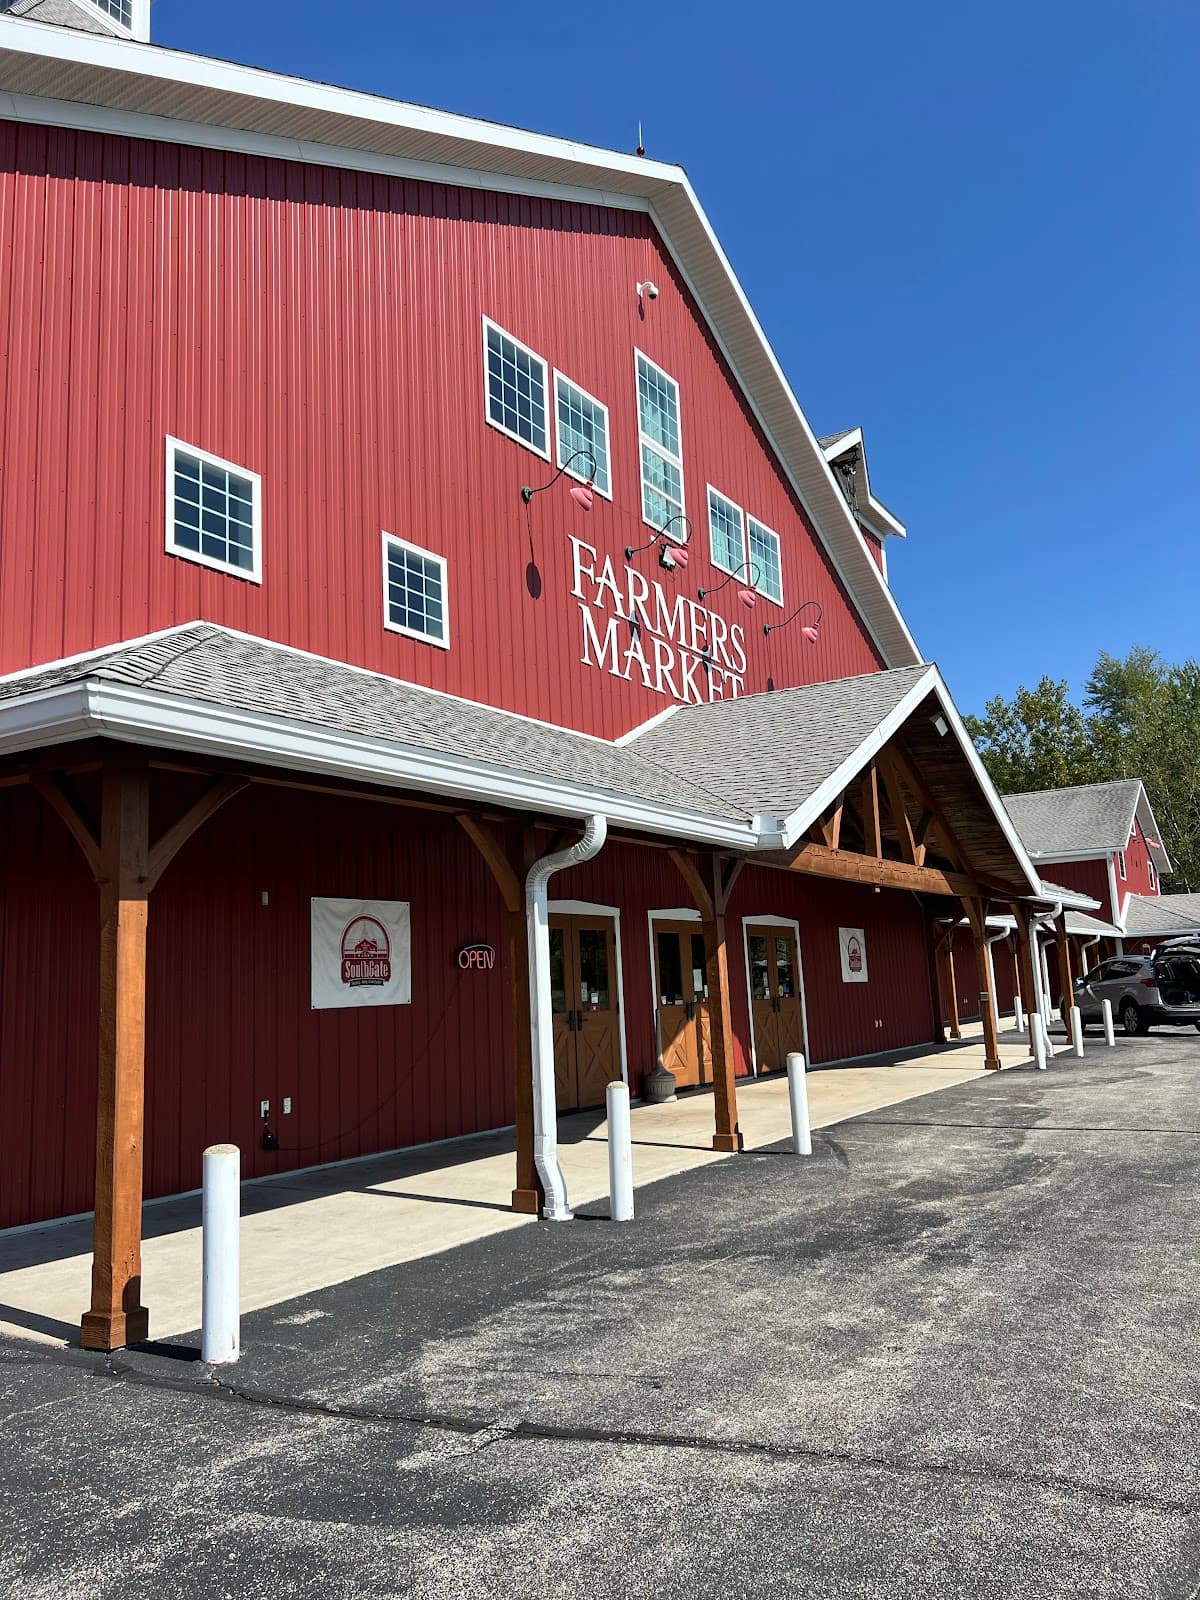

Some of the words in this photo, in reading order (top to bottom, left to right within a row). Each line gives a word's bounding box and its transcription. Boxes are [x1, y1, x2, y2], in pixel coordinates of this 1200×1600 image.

[568, 534, 747, 675] FARMERS
[345, 960, 389, 978] SouthGate
[458, 950, 494, 969] OPEN
